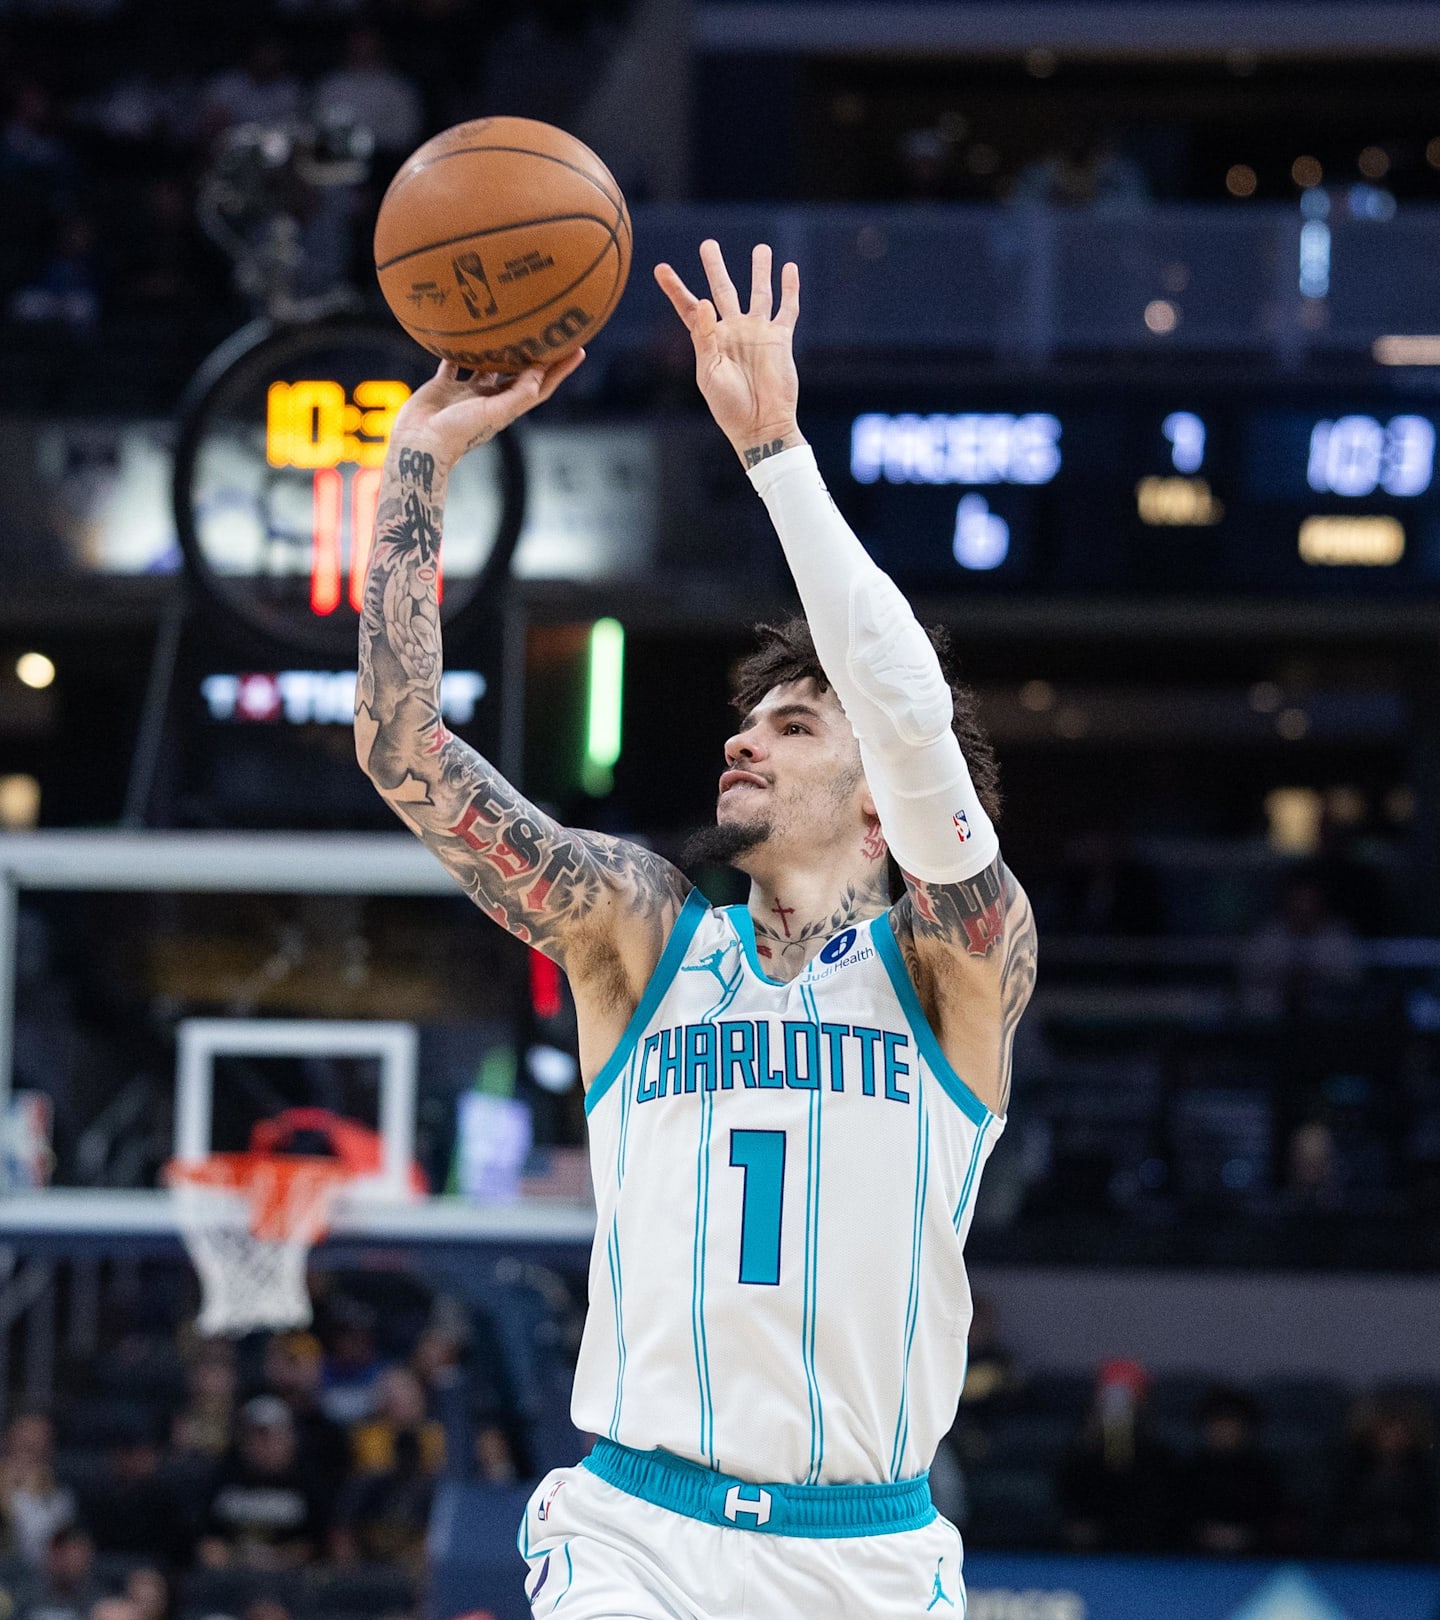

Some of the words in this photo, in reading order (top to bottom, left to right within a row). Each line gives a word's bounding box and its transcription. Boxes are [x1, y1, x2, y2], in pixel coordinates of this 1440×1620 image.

[399, 447, 435, 486] GOD
[636, 1020, 910, 1104] CHARLOTTE
[729, 1128, 786, 1286] 1
